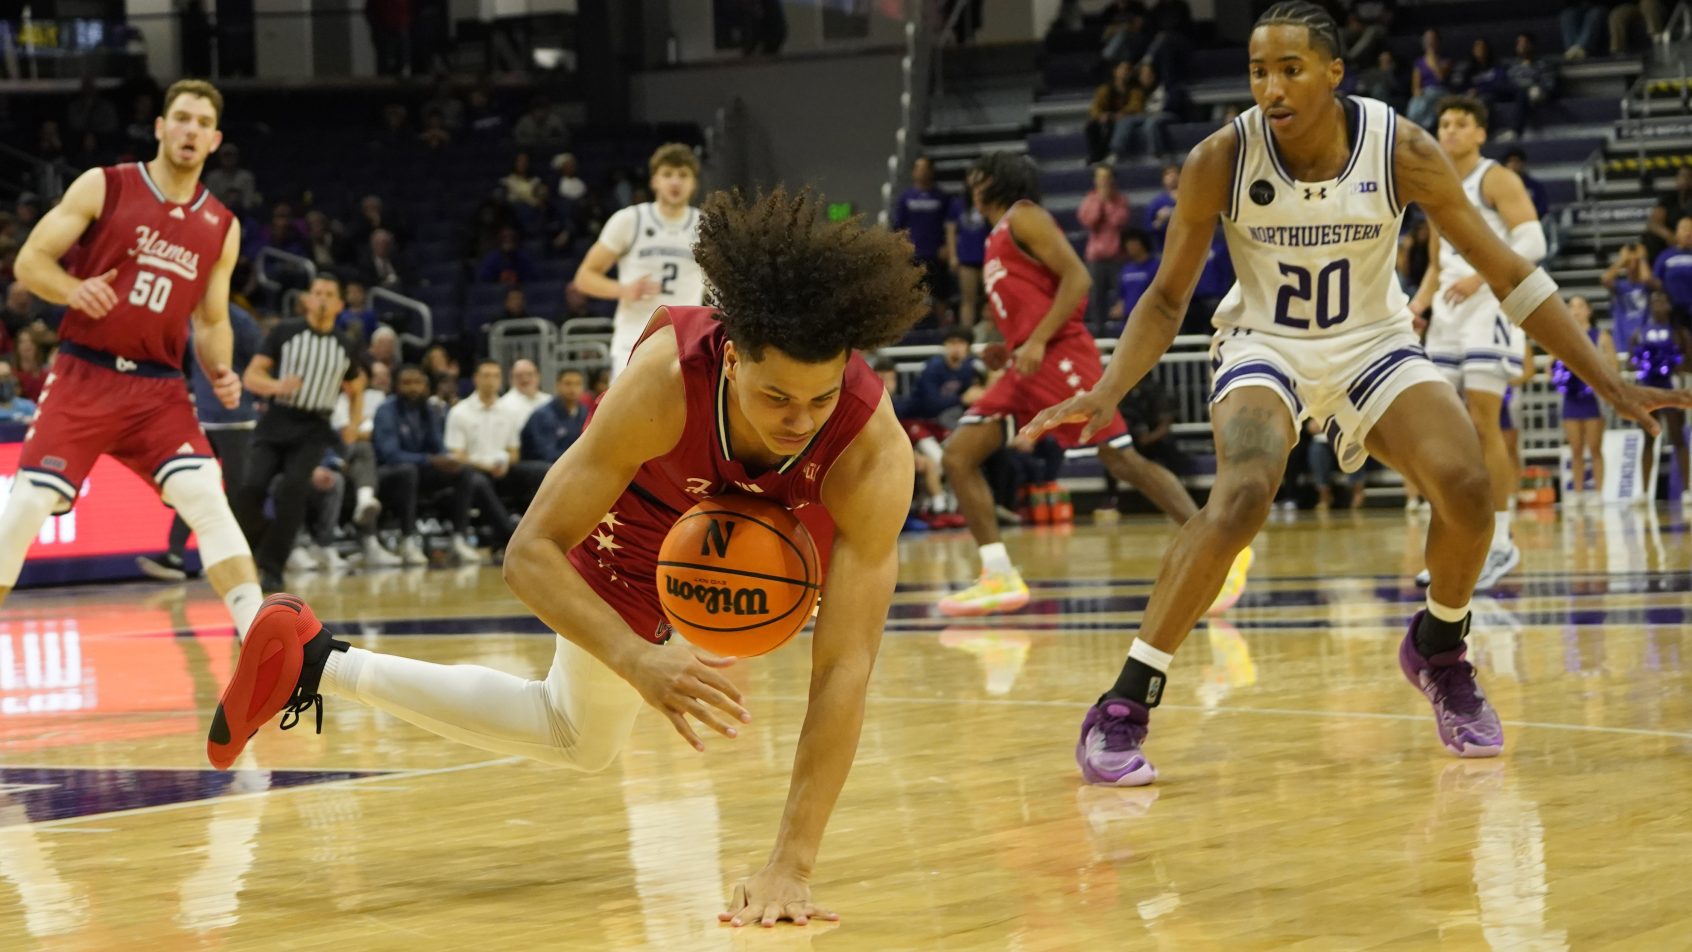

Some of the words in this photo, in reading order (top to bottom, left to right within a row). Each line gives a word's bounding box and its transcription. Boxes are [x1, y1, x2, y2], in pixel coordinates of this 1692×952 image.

[127, 225, 200, 269] Flames
[1248, 223, 1384, 248] NORTHWESTERN
[128, 270, 173, 314] 50
[660, 261, 679, 296] 2
[1274, 257, 1350, 331] 20
[701, 518, 735, 558] N
[665, 574, 769, 615] Wilson
